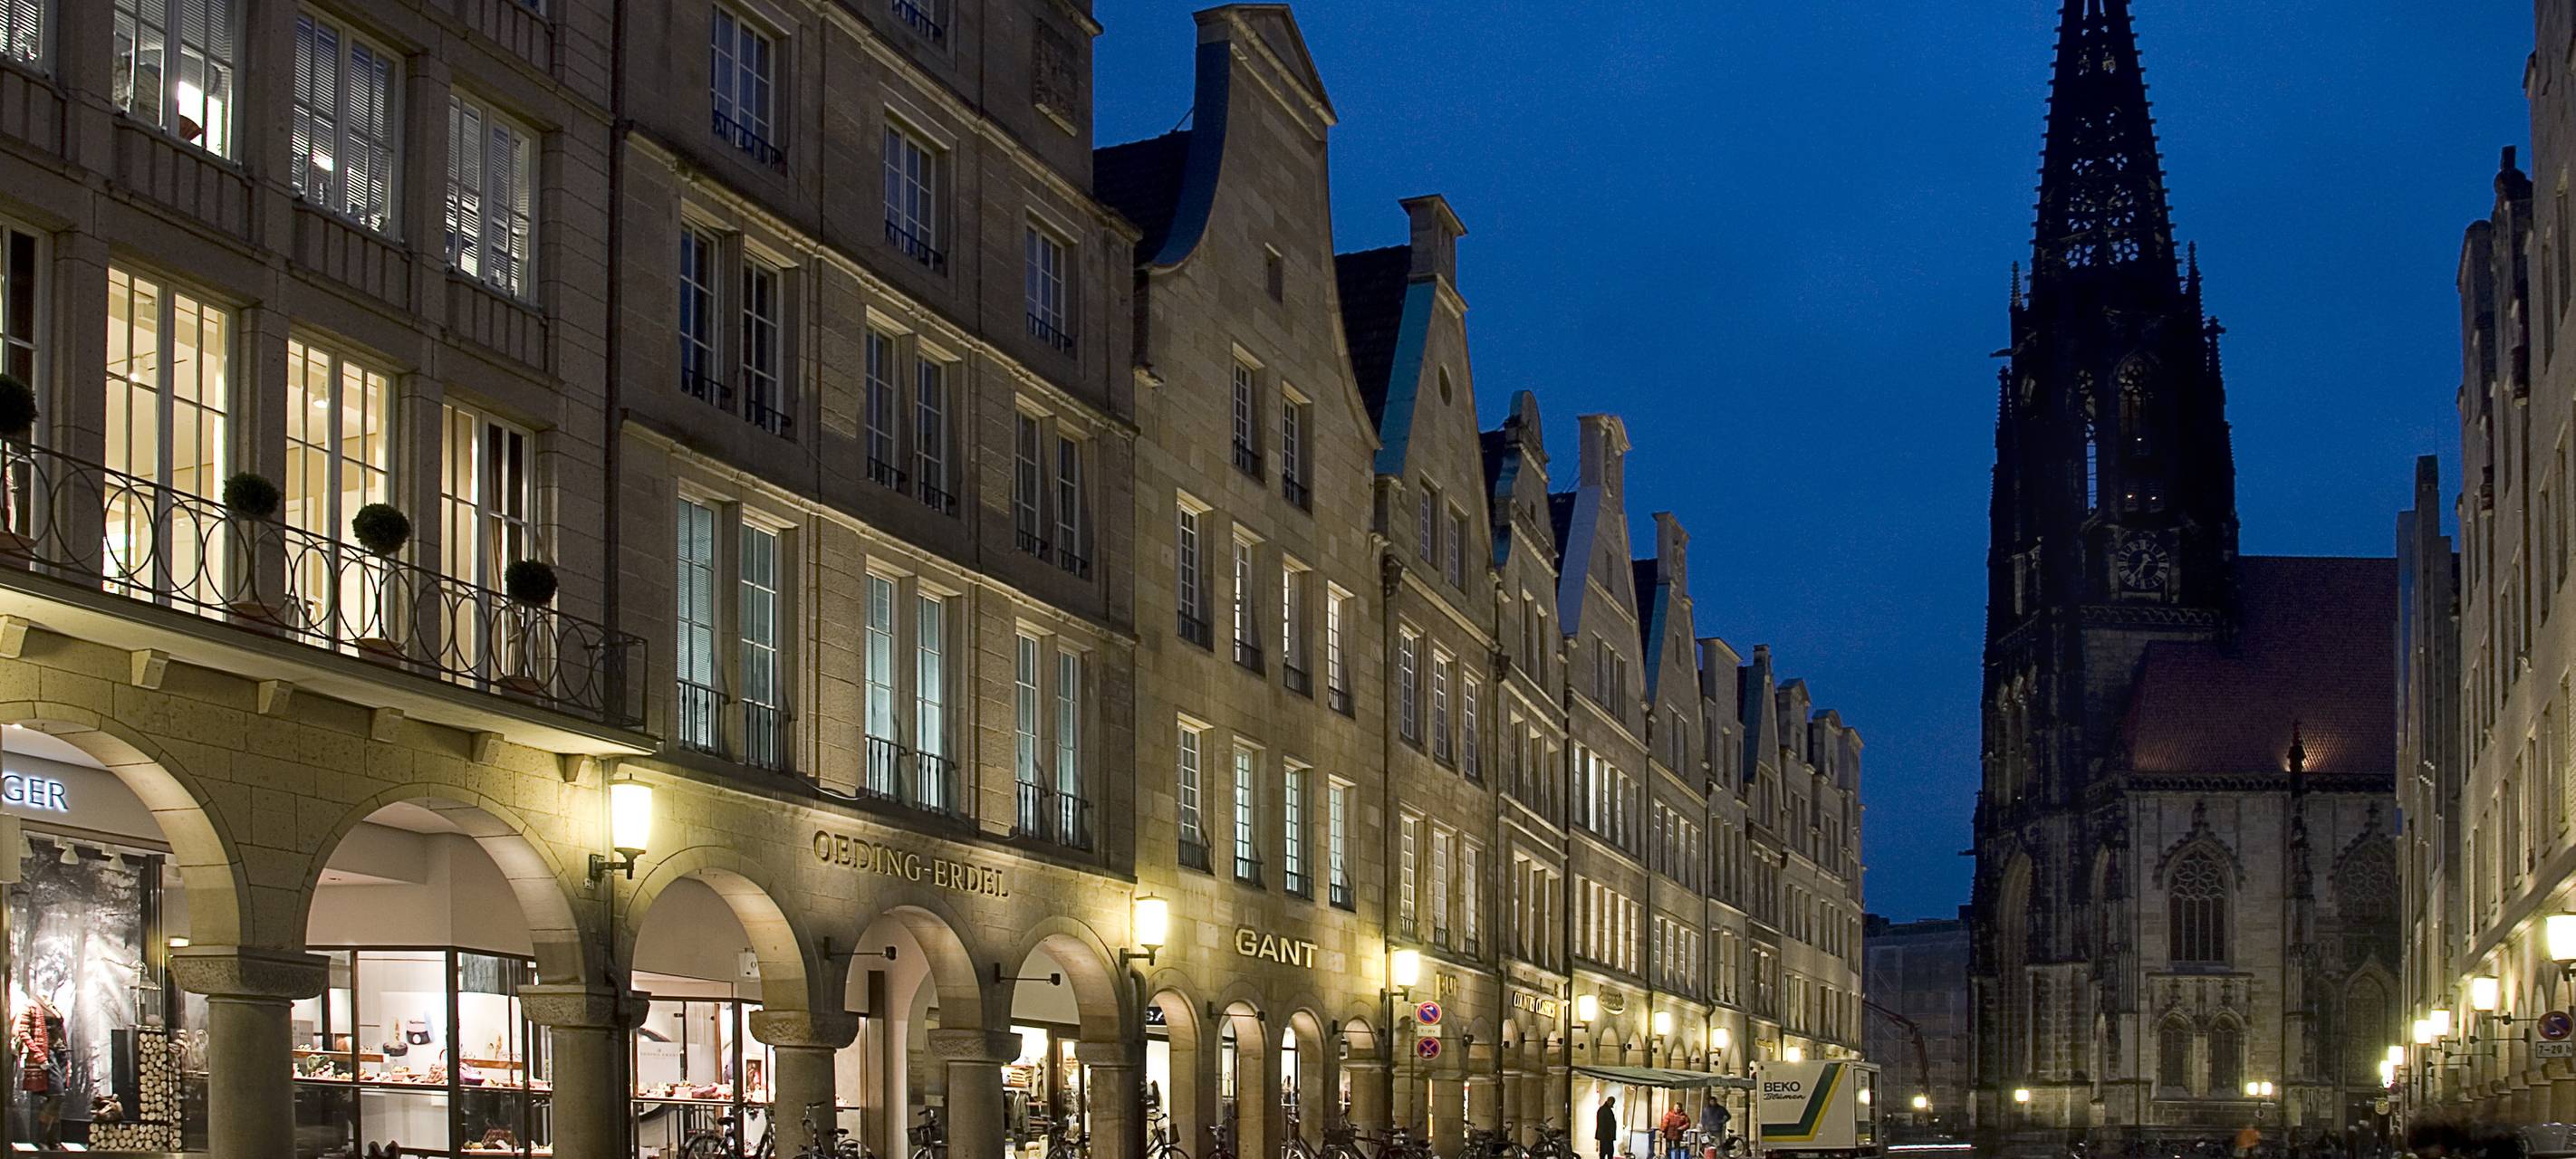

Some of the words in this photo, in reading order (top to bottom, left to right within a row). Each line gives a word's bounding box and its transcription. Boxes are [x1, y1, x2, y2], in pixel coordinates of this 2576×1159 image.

[813, 829, 1011, 901] OEDING-ERDEL
[1235, 927, 1319, 970] GANT
[1764, 1081, 1801, 1093] BEKO
